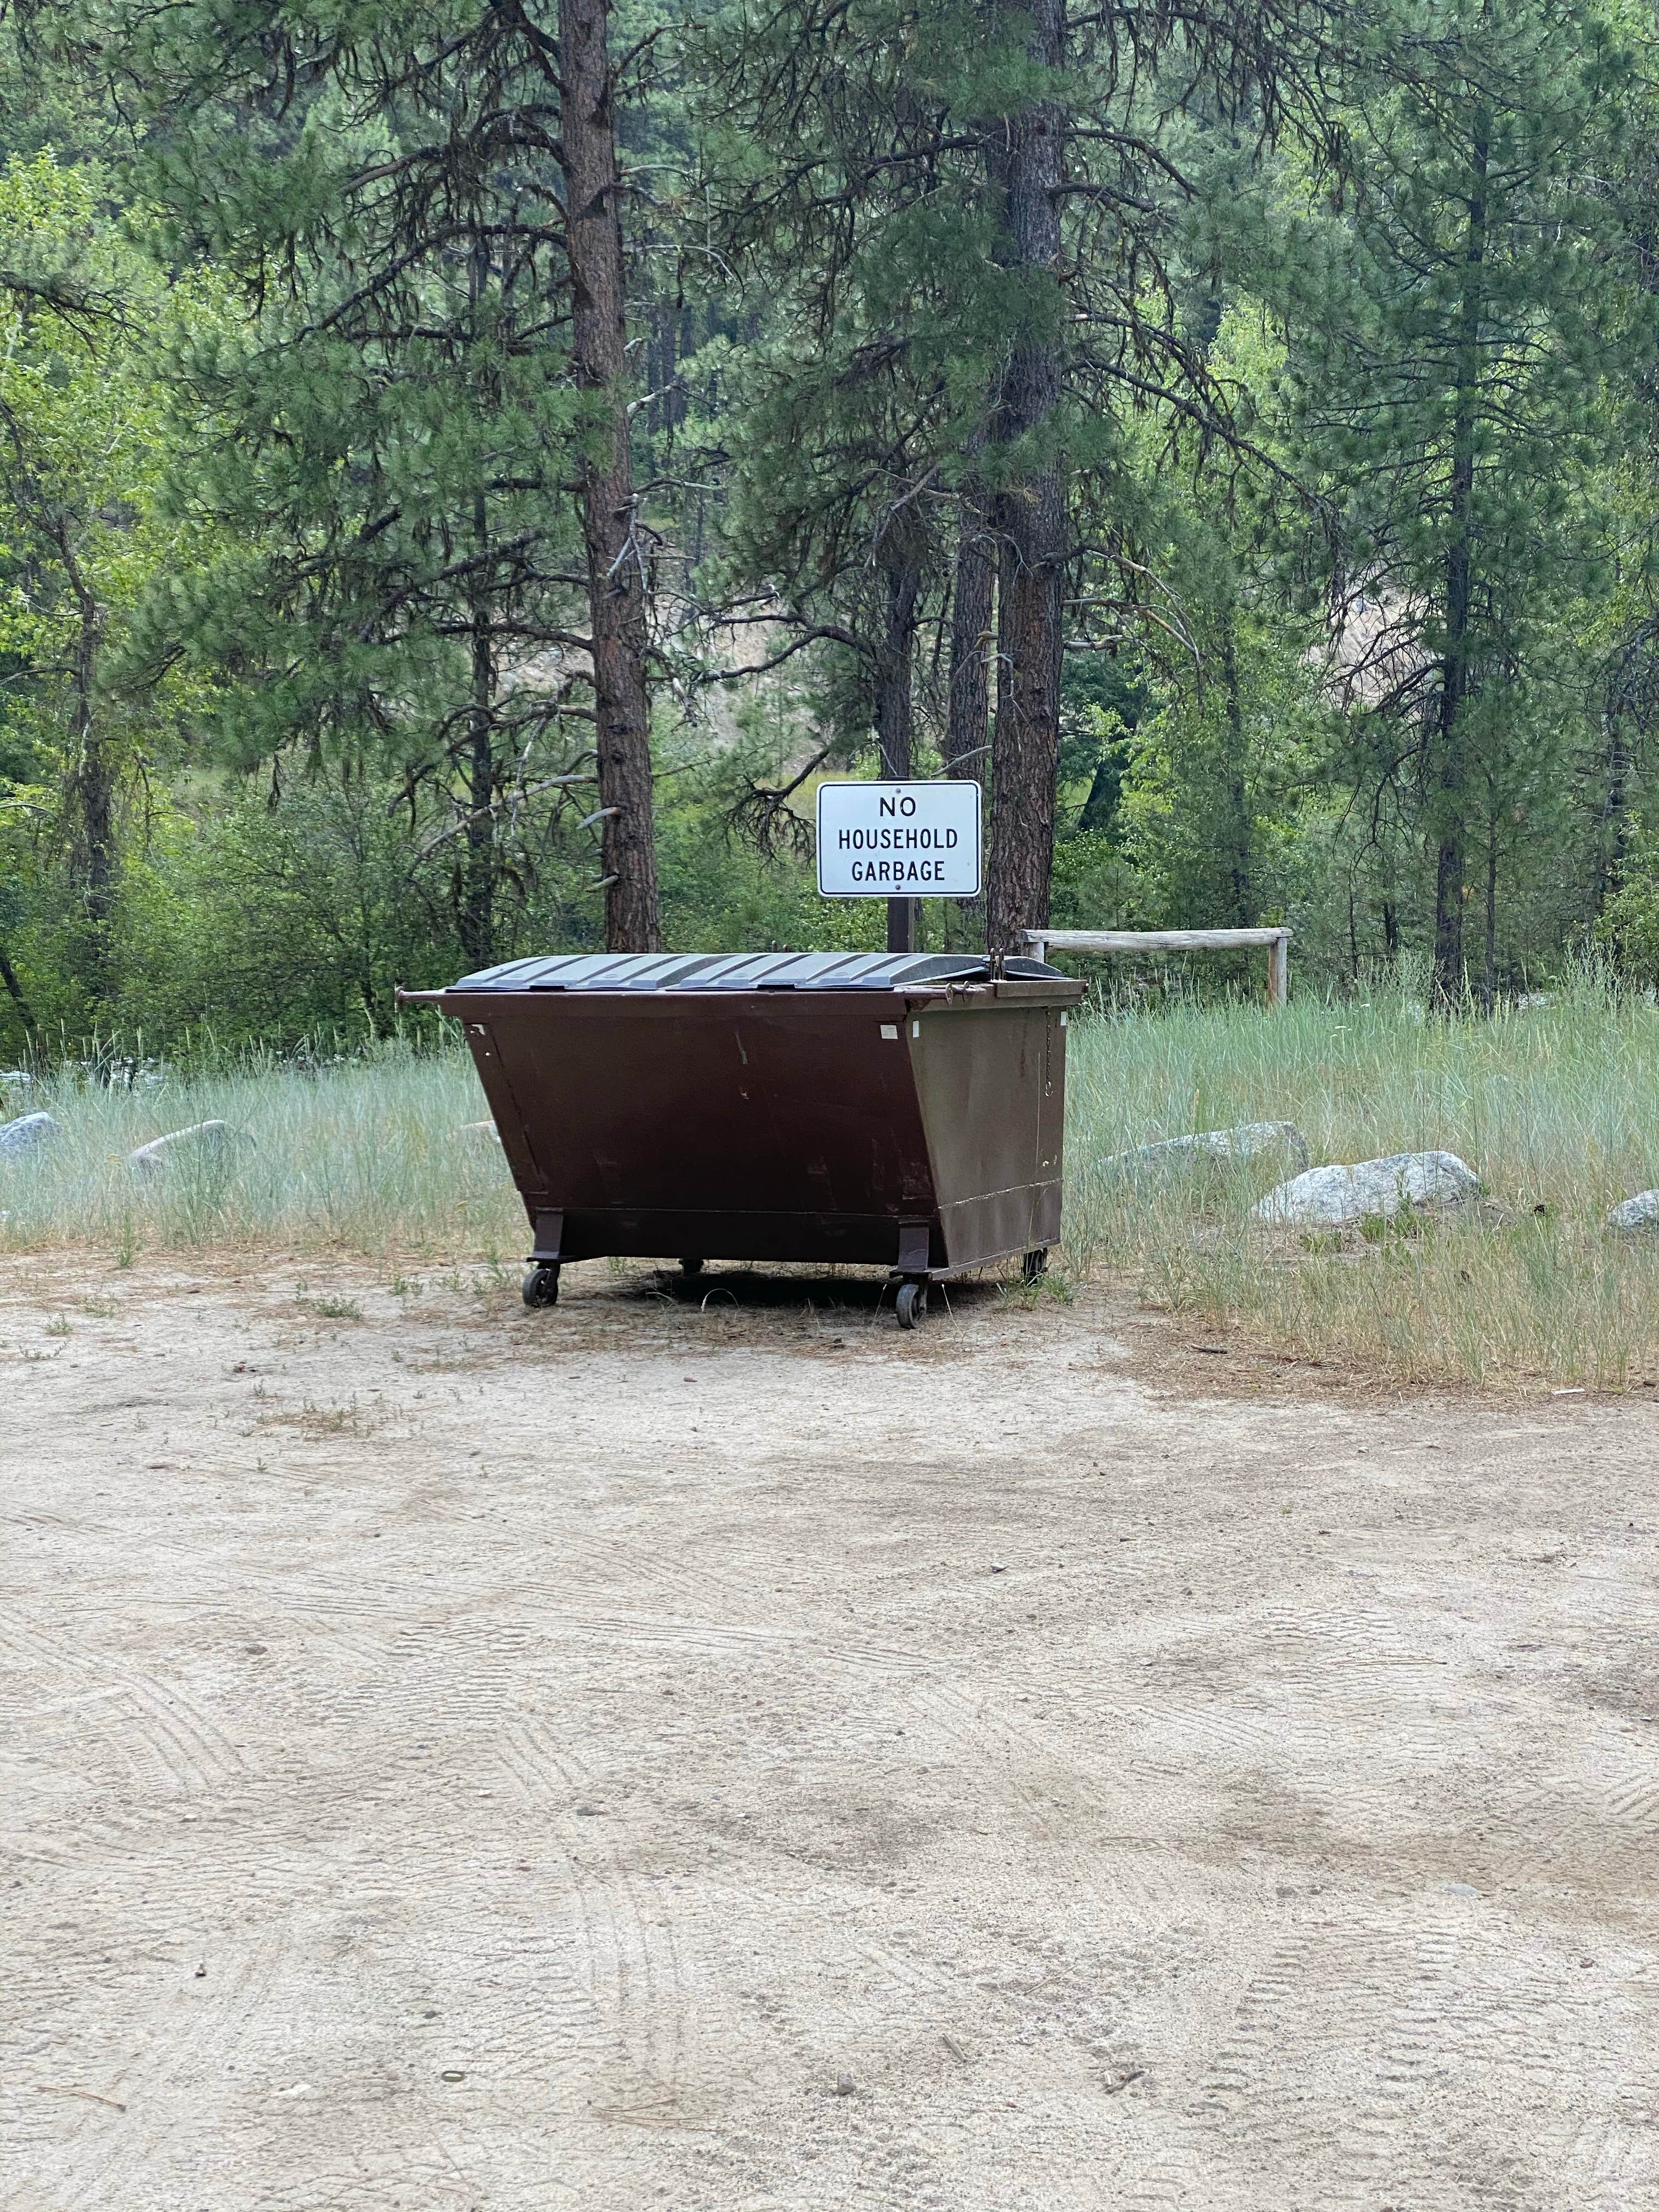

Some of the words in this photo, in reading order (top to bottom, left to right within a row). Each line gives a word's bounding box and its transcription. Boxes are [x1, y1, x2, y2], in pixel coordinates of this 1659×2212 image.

[879, 797, 916, 817] NO
[839, 828, 957, 849] HOUSEHOLD
[851, 860, 945, 881] GARBAGE
